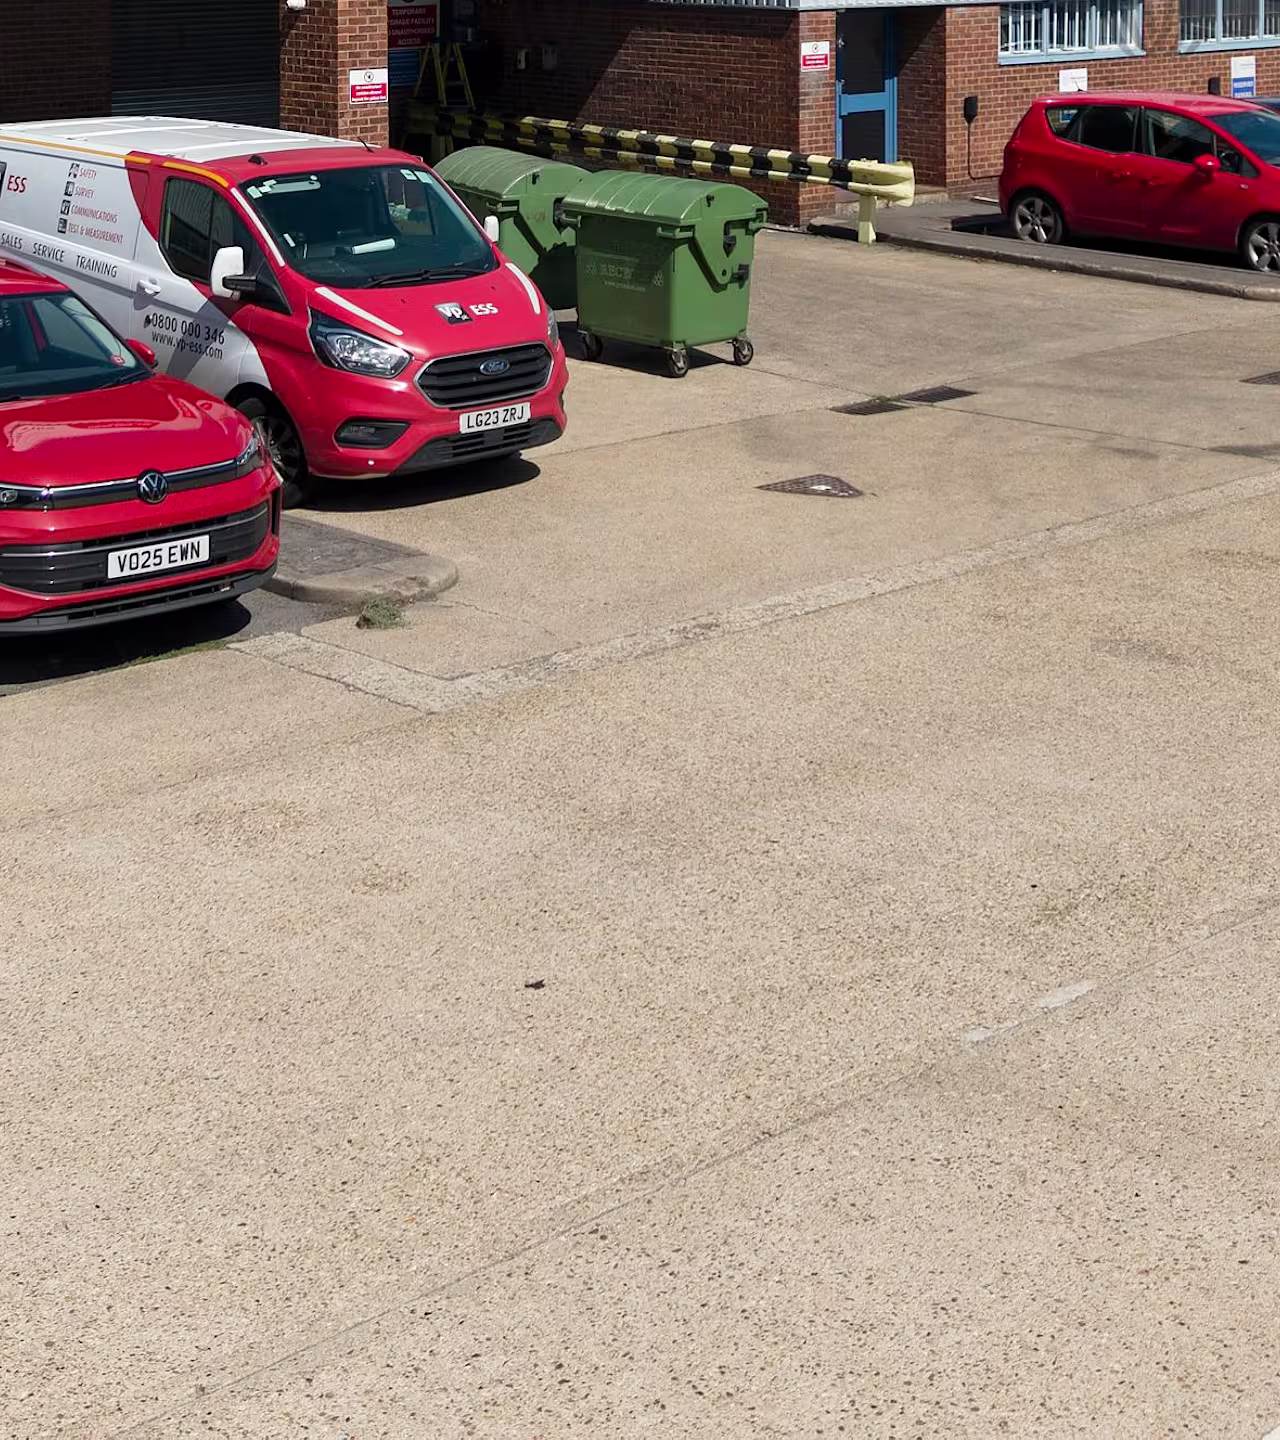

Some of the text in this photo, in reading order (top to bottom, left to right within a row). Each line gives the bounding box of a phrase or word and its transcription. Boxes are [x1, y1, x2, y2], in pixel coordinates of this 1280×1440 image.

[6, 174, 28, 194] ESS
[78, 167, 97, 180] SAFETY
[74, 186, 95, 199] SURVEY
[70, 204, 118, 224] COMMUNICATIONS
[68, 222, 79, 234] TEST
[84, 225, 123, 245] MEASUREMENT
[1, 232, 23, 250] SALES
[32, 242, 65, 263] SERVICE
[75, 254, 118, 278] TRAINING
[469, 302, 499, 316] ESS
[152, 312, 225, 345] 0800 000 346
[151, 331, 223, 360] www.vp-ess.com
[467, 405, 525, 429] LG23 ZRJ
[117, 540, 200, 573] VO25 EWN
